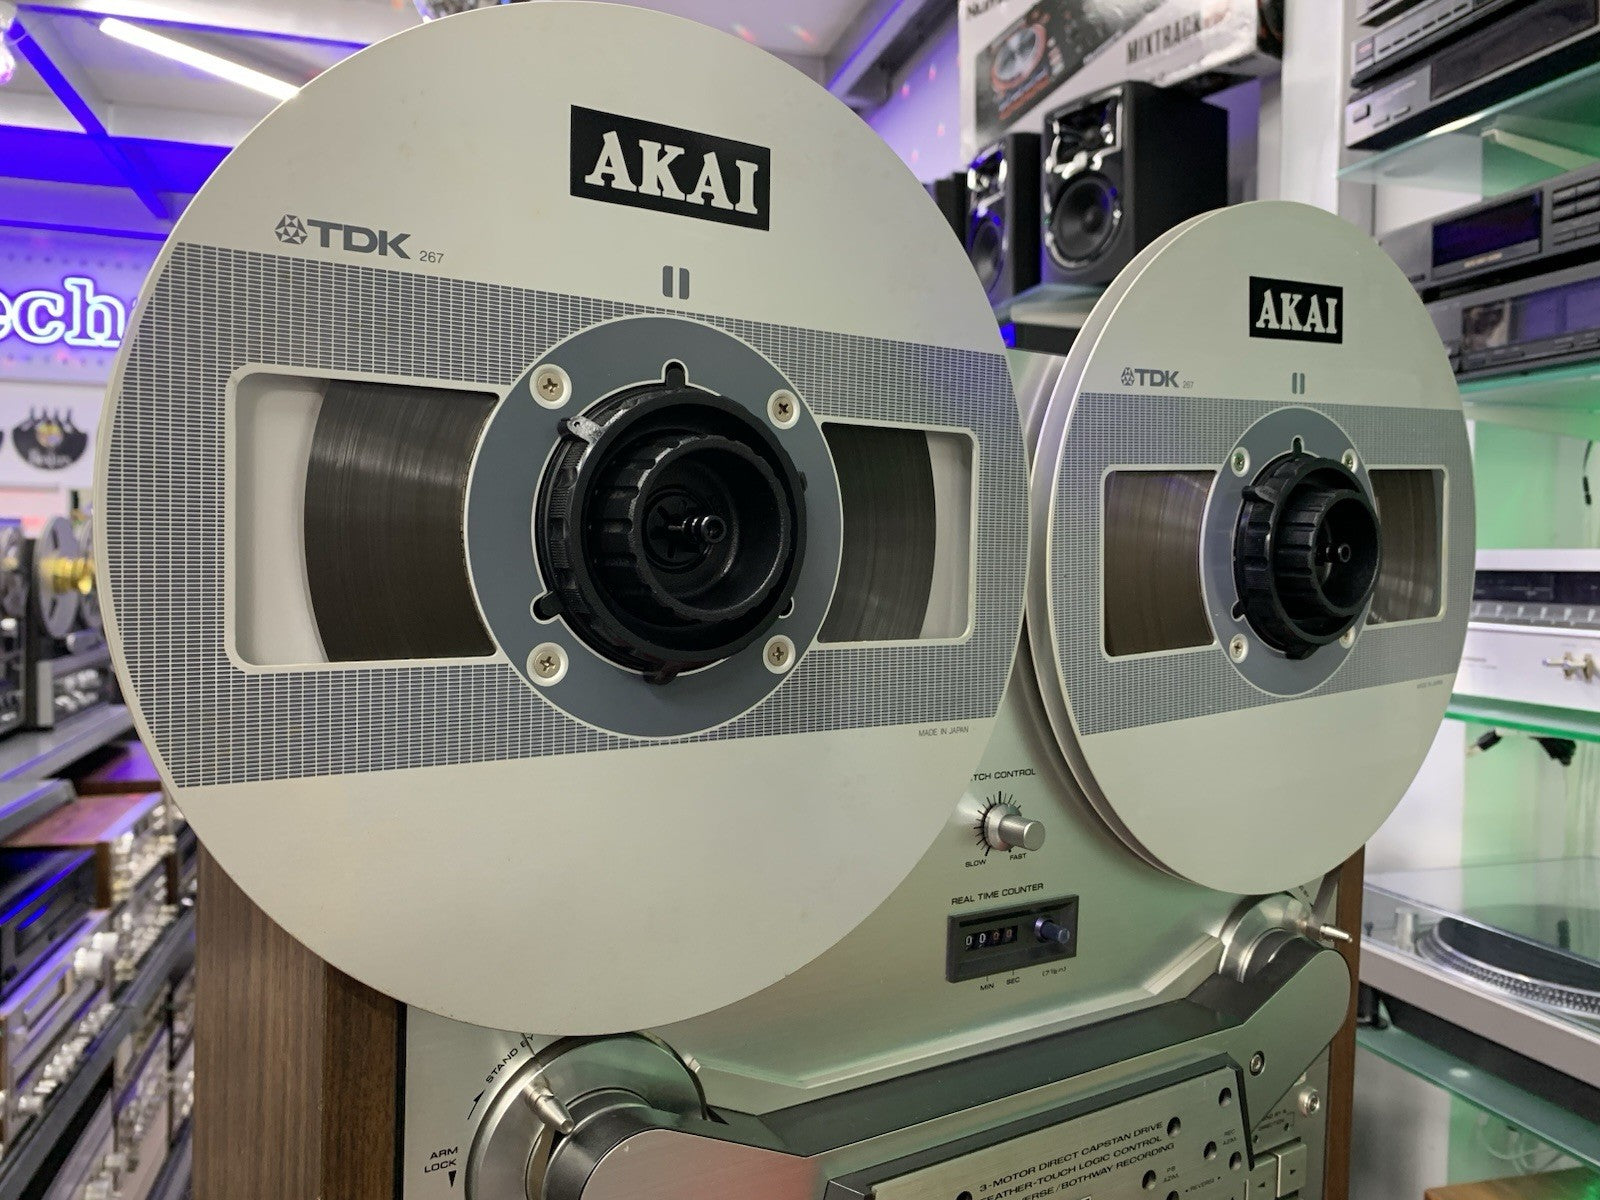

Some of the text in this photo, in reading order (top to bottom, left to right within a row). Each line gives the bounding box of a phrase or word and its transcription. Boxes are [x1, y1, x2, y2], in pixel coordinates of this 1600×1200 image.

[584, 130, 759, 215] AKAI
[306, 218, 445, 264] TDK 267
[1255, 288, 1338, 334] AKAI
[1134, 368, 1180, 388] TDK
[918, 728, 937, 736] MADE
[949, 726, 969, 735] JAPAN
[970, 768, 1036, 782] TCH CONTROL
[965, 859, 987, 868] SLOW
[1009, 853, 1027, 861] FAST
[951, 883, 1044, 906] REAL TIME COUNTER
[980, 976, 1021, 991] MIN SEC
[486, 1047, 519, 1084] STAND
[429, 1146, 459, 1160] ARM
[979, 1121, 1163, 1193] 3-MOTOR DIRECT CAPSTAN DRIVE
[1078, 1152, 1111, 1171] LOGIC
[1113, 1135, 1162, 1159] CONTROL
[1115, 1142, 1175, 1169] RECORDING
[424, 1158, 457, 1173] LOCK
